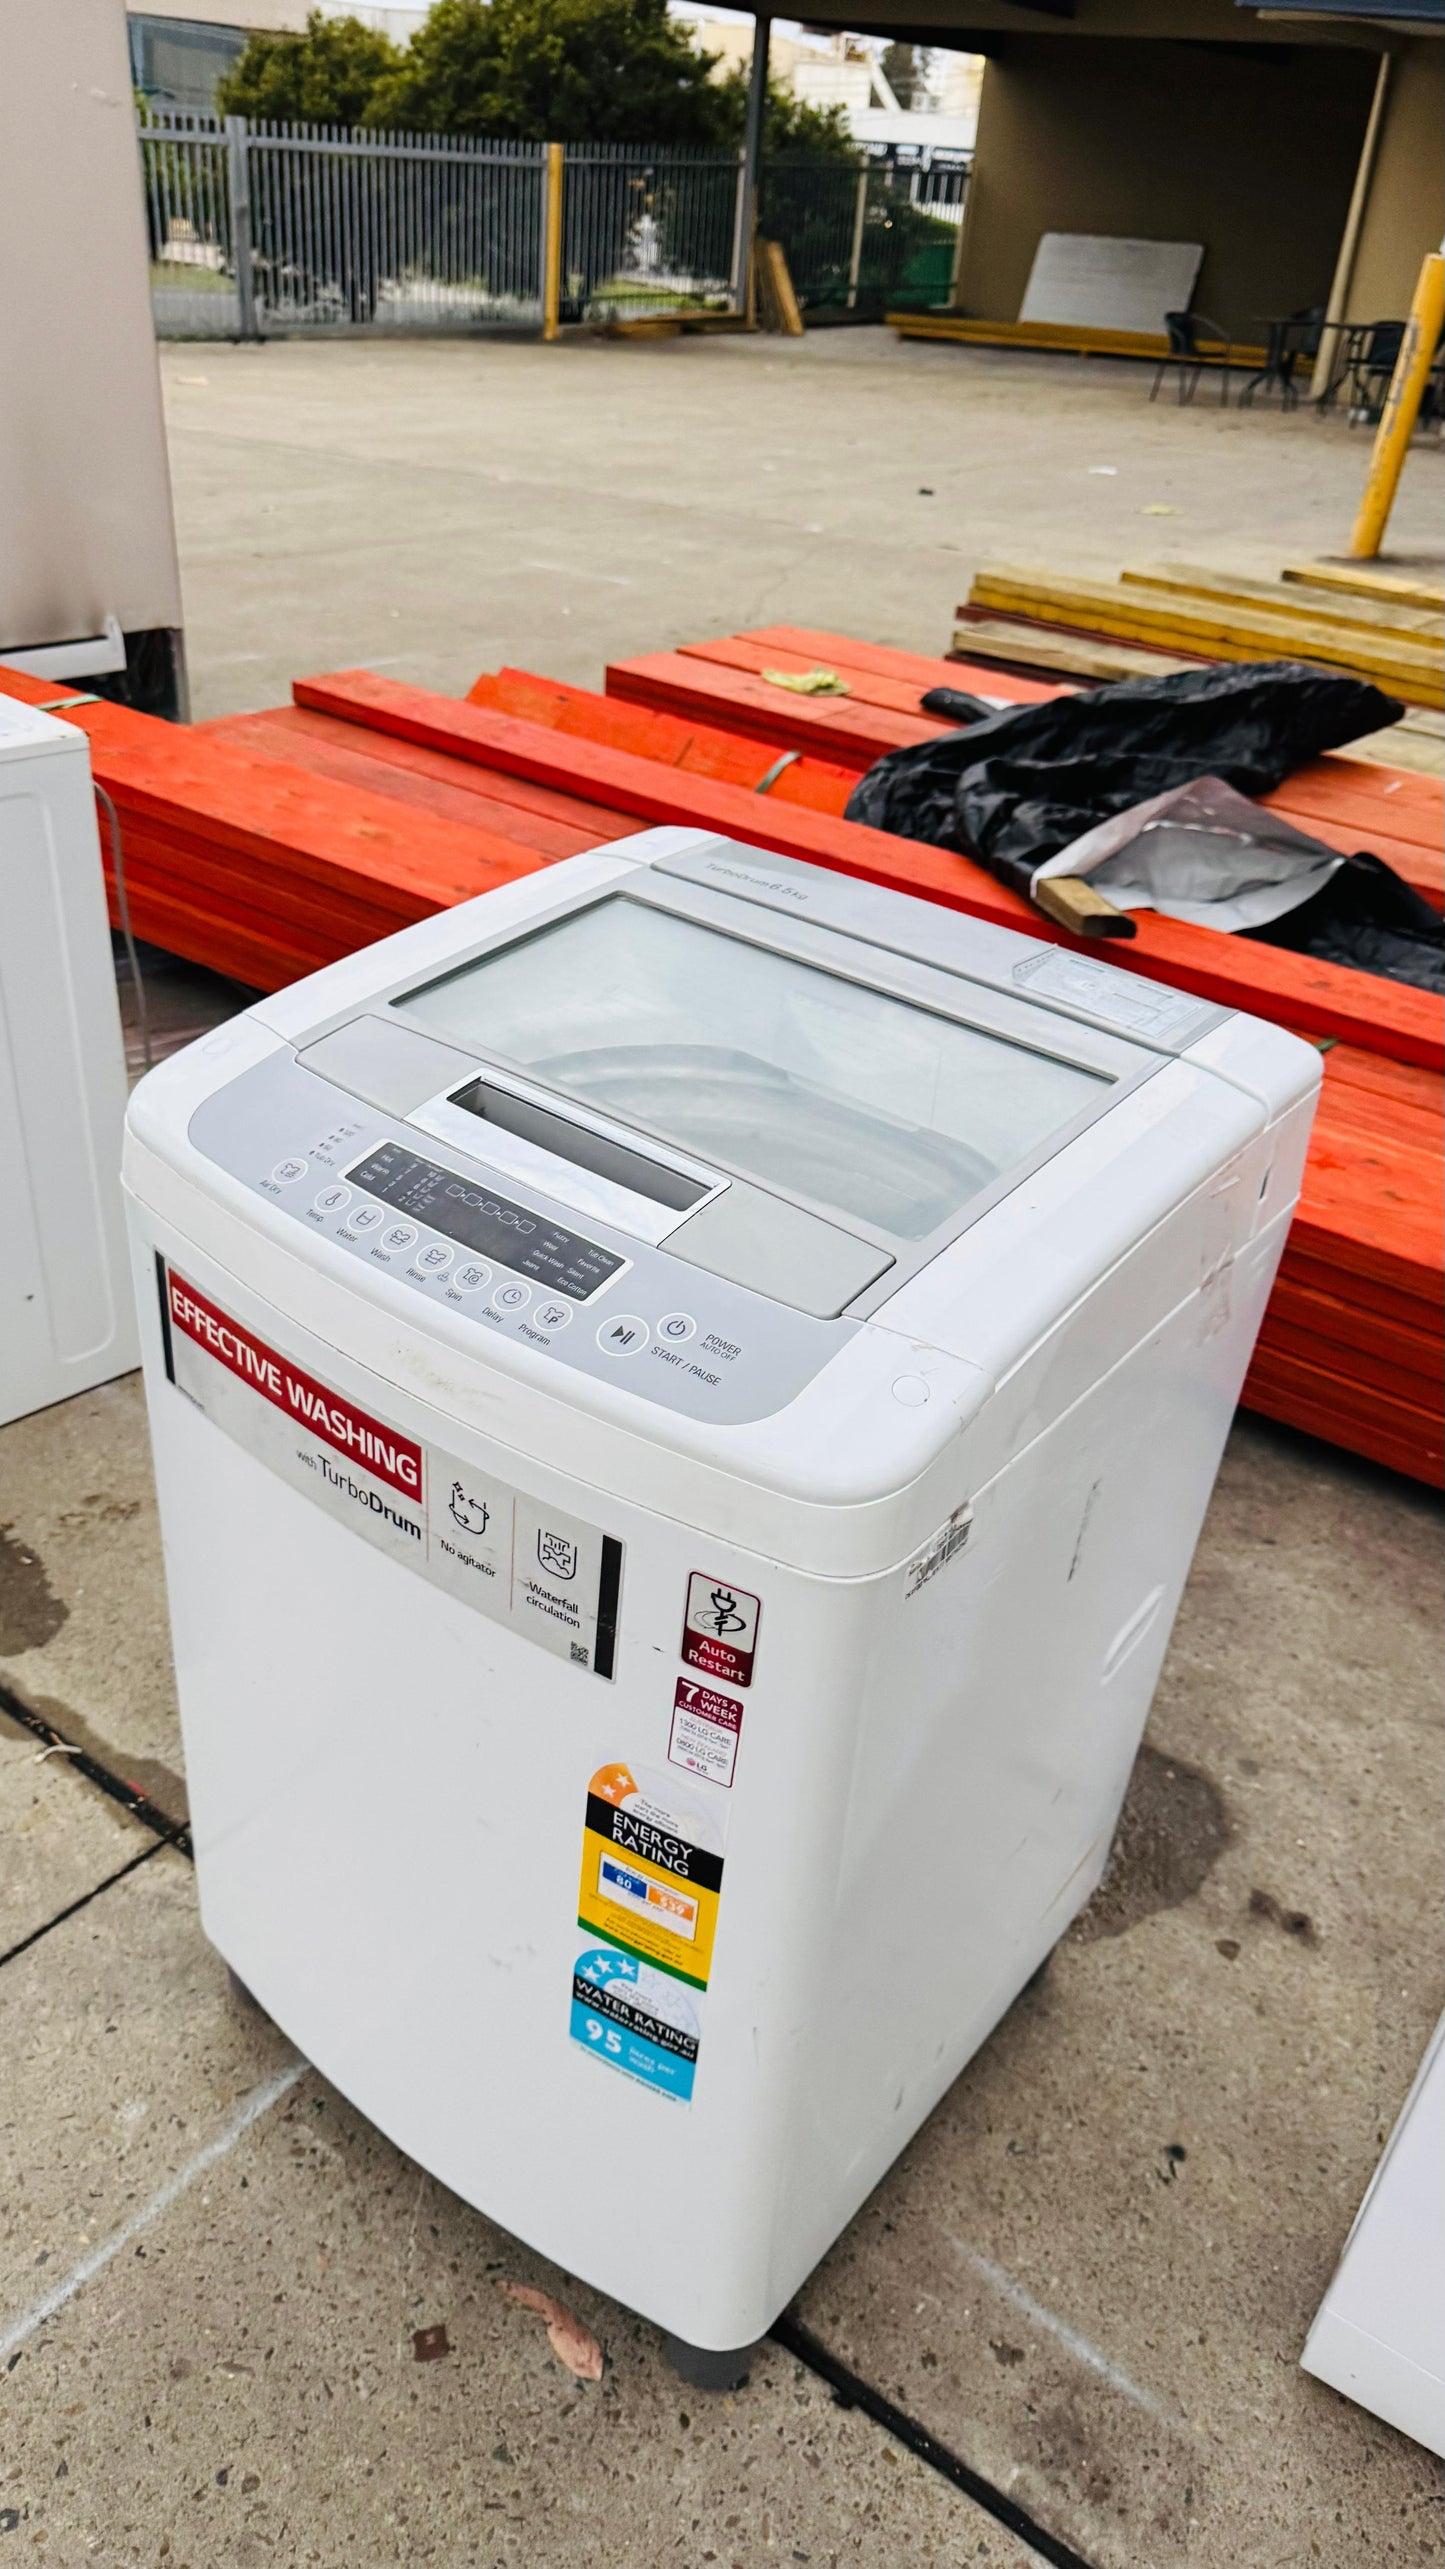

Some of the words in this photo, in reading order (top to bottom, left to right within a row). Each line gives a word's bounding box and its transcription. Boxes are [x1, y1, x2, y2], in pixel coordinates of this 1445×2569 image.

[306, 1209, 325, 1223] Temp
[336, 1227, 358, 1242] Water
[553, 1231, 570, 1244] Fuzzy
[370, 1247, 391, 1262] Wash
[533, 1249, 549, 1261] Quick
[548, 1257, 565, 1269] Wash
[587, 1249, 599, 1259] Tub
[405, 1267, 426, 1283] Rinse
[556, 1277, 569, 1286] Eco
[568, 1281, 588, 1296] Cotton
[445, 1288, 463, 1302] Spin
[481, 1307, 504, 1324] Delay
[518, 1323, 551, 1346] Program
[705, 1334, 742, 1356] POWER
[699, 1342, 720, 1355] AUTO
[720, 1352, 737, 1362] OFF
[651, 1346, 684, 1366] START
[688, 1365, 722, 1386] PAUSE
[171, 1286, 283, 1396] EFFECTIVE
[286, 1376, 418, 1486] WASHING
[296, 1449, 317, 1471] with
[317, 1454, 422, 1540] TurboDrum
[440, 1539, 456, 1556] No
[457, 1551, 496, 1579] agitator
[529, 1581, 579, 1615] Waterfall
[526, 1595, 580, 1629] circulation
[699, 1640, 736, 1663] Auto
[688, 1649, 745, 1682] Restart
[681, 1681, 700, 1703] 7
[702, 1690, 728, 1707] DAYS
[730, 1704, 738, 1712] A
[679, 1700, 717, 1722] CUSTOMER
[718, 1718, 737, 1731] CARE
[700, 1699, 737, 1723] WEEK
[696, 1762, 708, 1771] LG
[613, 1810, 693, 1860] ENERGY
[612, 1827, 689, 1876] RATING
[615, 1873, 632, 1890] 80
[576, 1978, 630, 2018] WATER
[634, 2012, 696, 2050] RATING
[585, 2018, 622, 2054] 95
